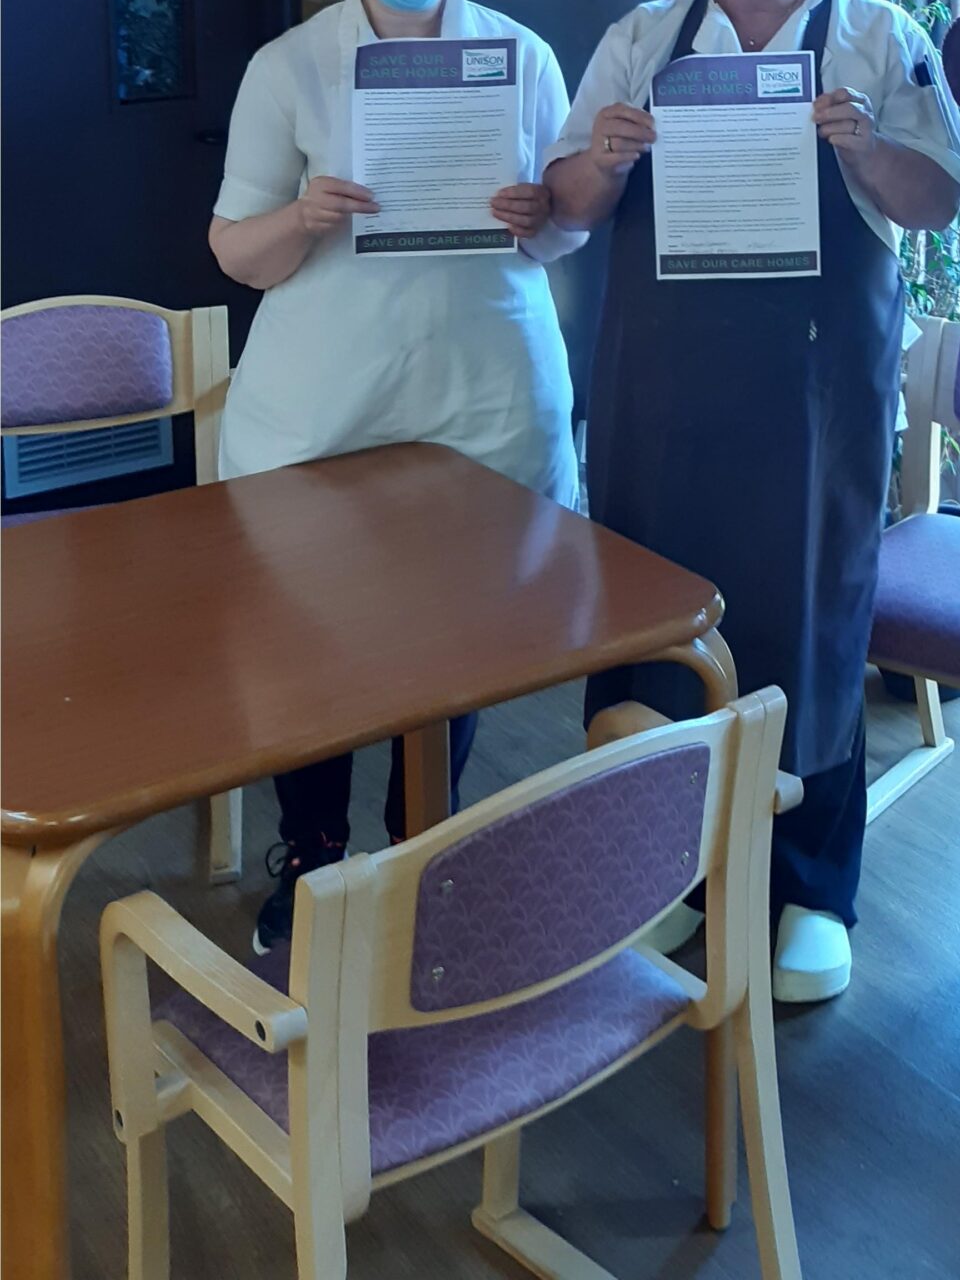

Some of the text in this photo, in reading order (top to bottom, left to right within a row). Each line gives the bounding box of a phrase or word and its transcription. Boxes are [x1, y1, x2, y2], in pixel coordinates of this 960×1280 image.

[369, 54, 444, 66] SAVE OUR
[466, 56, 504, 66] UNISON
[360, 68, 400, 79] CARE
[405, 67, 457, 78] HOMES
[666, 70, 739, 82] SAVE OUR
[760, 70, 799, 81] UNISON
[657, 83, 753, 96] CARE HOMES
[364, 233, 506, 248] SAVE OUR CARE HOMES
[667, 256, 810, 270] SAVE OUR CARE HOMES
